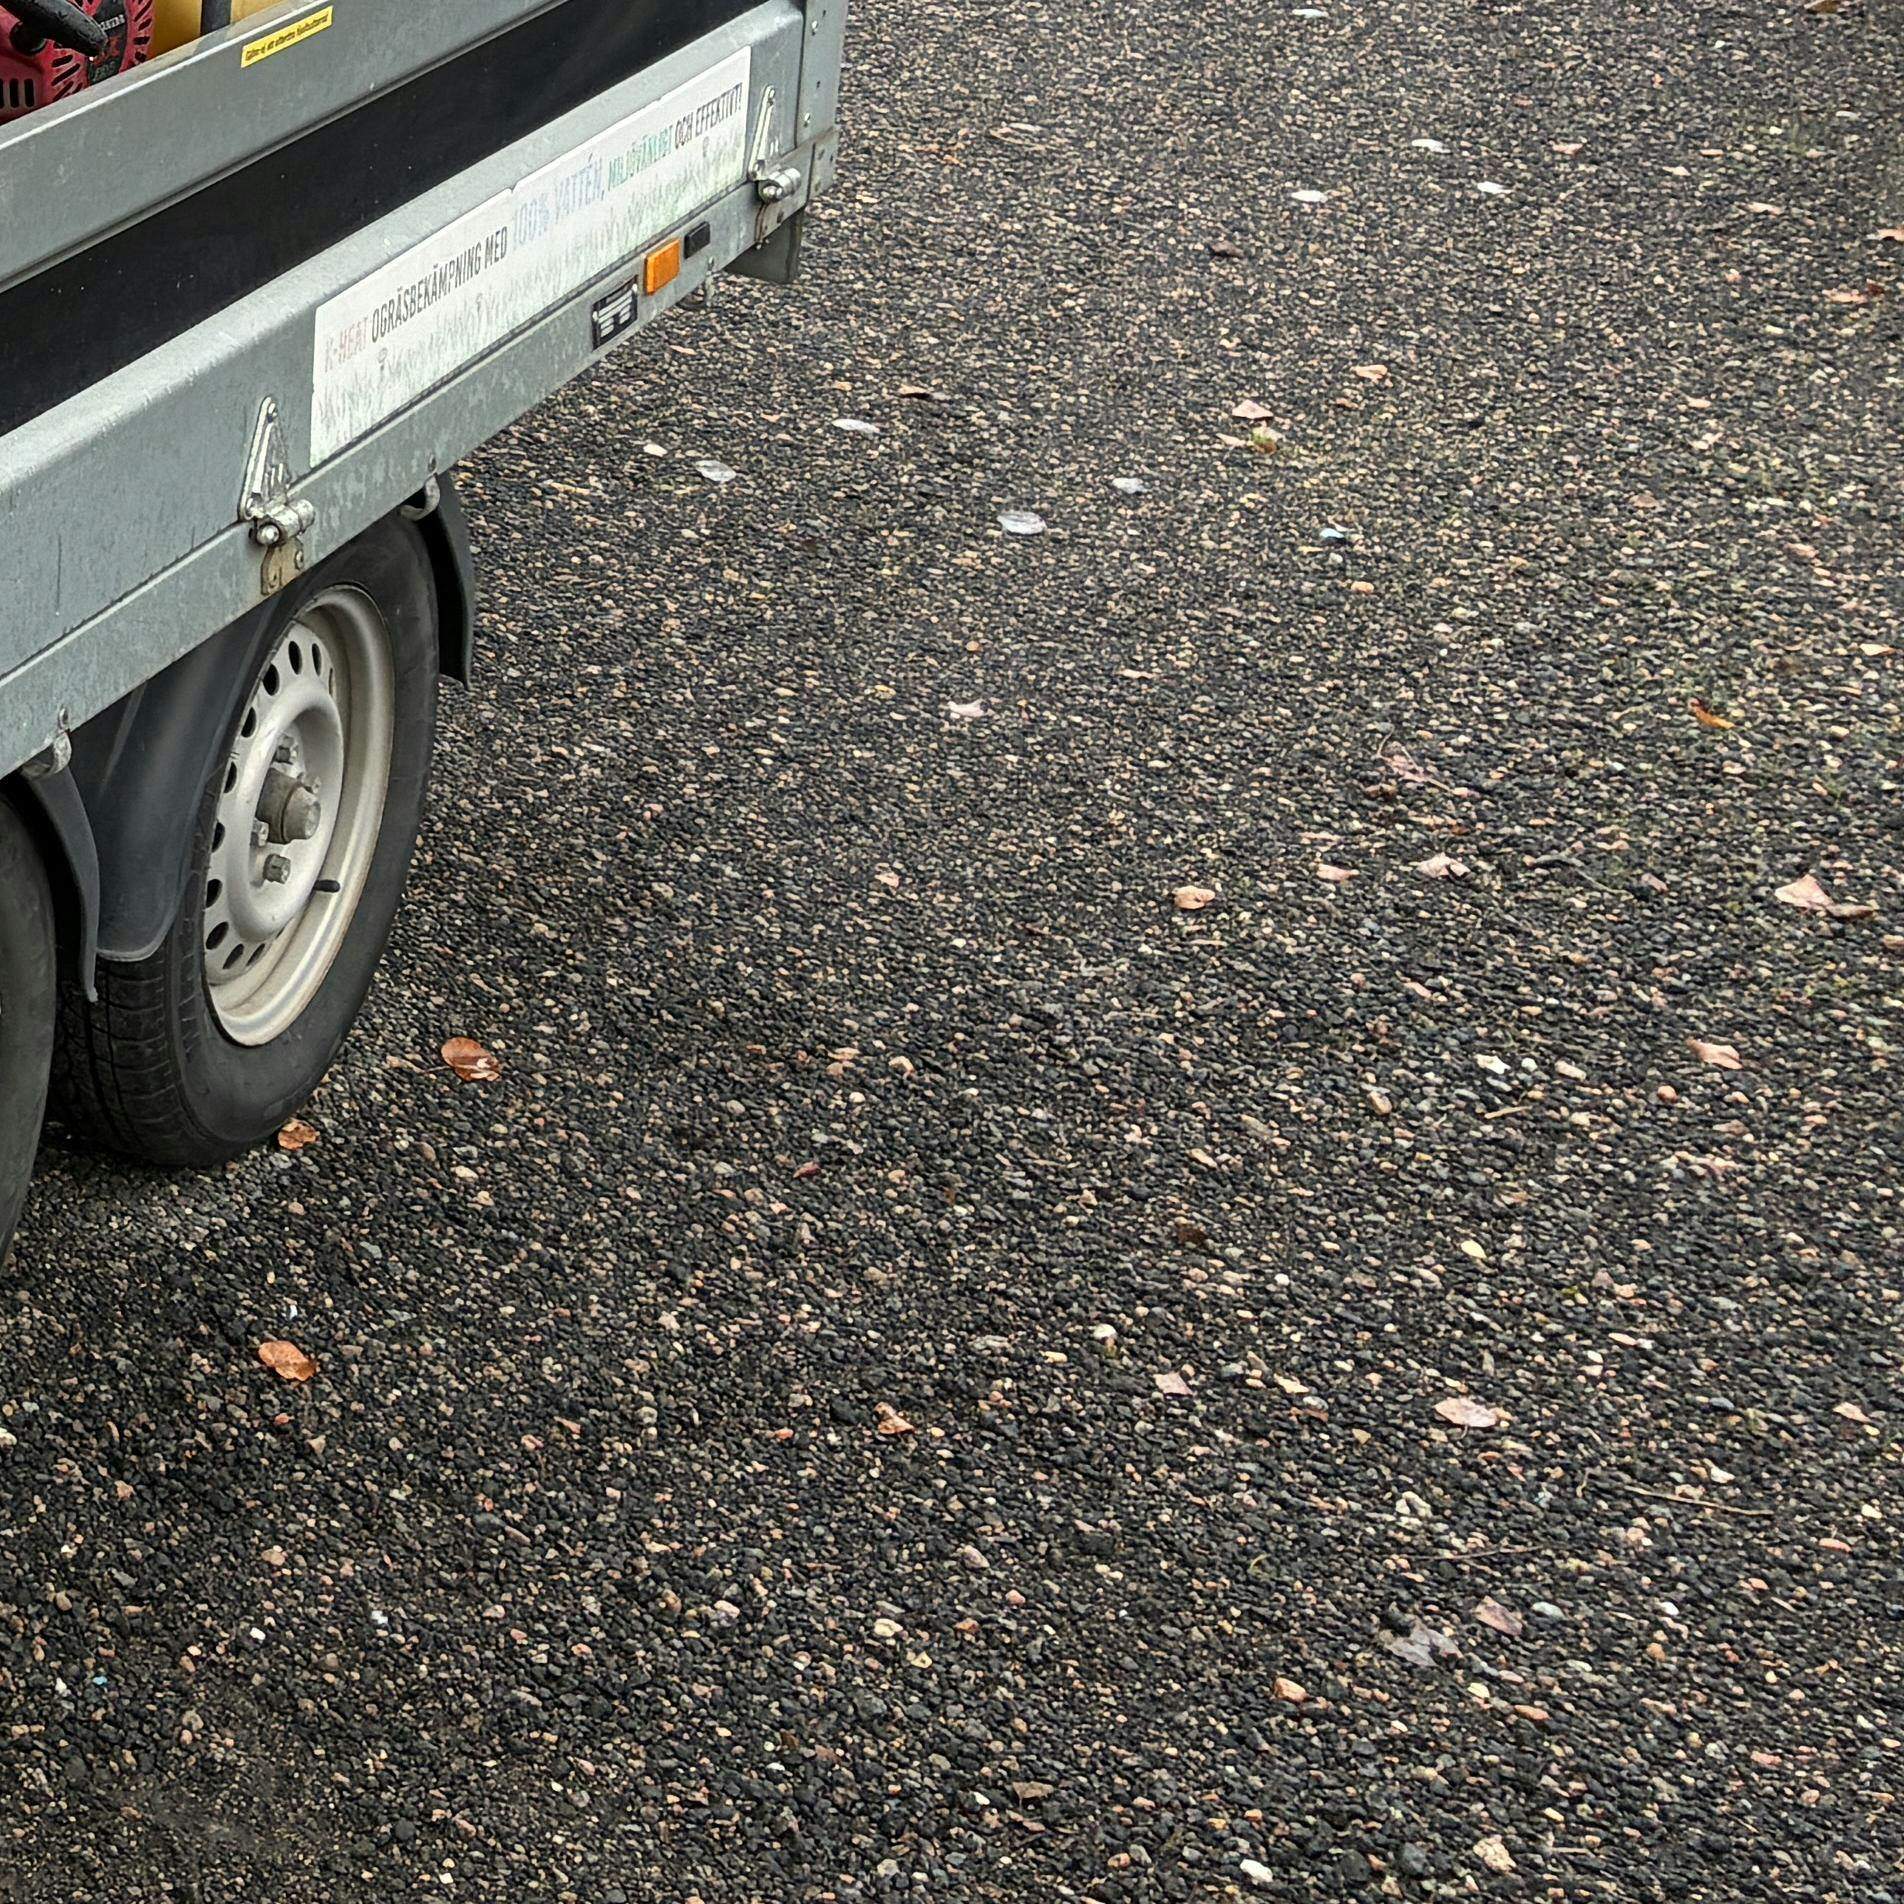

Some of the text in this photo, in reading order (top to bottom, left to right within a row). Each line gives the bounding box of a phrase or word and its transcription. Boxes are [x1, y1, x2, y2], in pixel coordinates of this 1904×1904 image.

[372, 242, 481, 343] OGRÄSBEKÄMPNING
[485, 226, 508, 269] MED
[675, 112, 693, 150] OCH
[695, 82, 743, 138] EFFEKTIVT!
